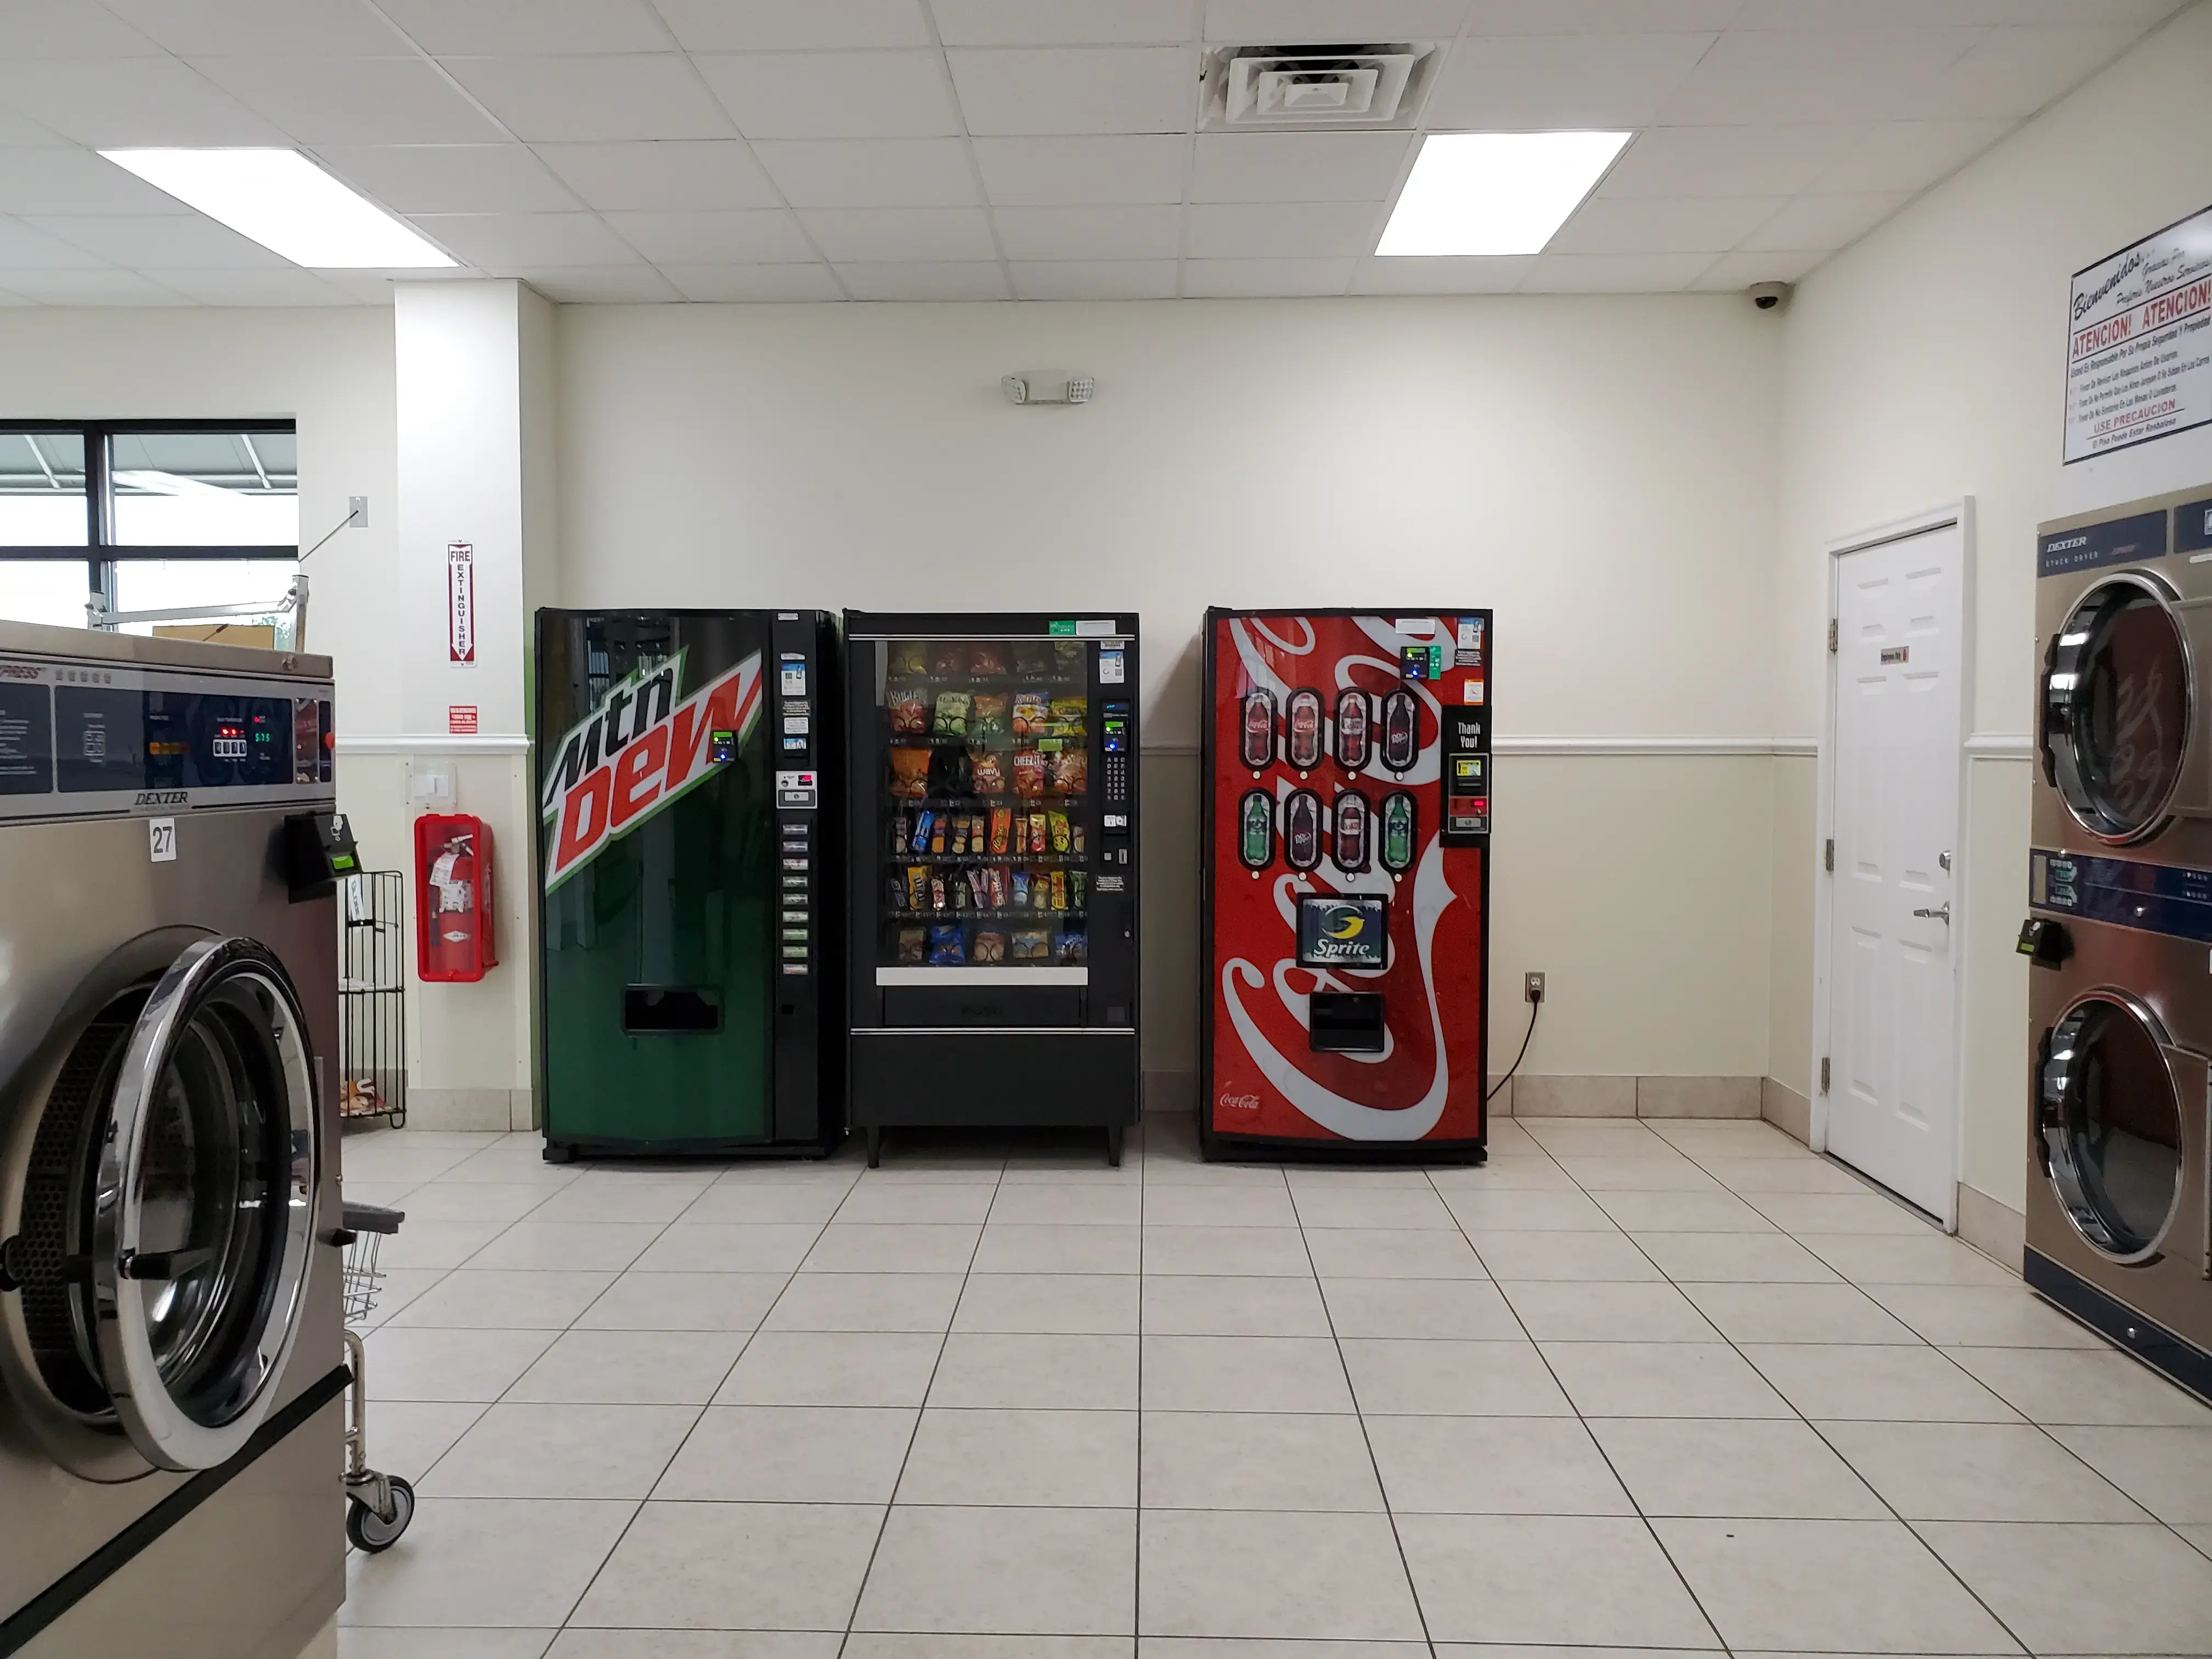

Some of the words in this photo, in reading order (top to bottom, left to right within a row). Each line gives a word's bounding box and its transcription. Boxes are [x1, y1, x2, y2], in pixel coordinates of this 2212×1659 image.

[2072, 314, 2132, 358] ATENCION!
[2142, 279, 2211, 330] ATENCION!
[2094, 419, 2112, 433] USE
[2114, 398, 2176, 427] PRECAUCION
[2046, 536, 2087, 553] DEXTER
[450, 550, 471, 562] FIRE
[456, 564, 466, 655] EXTINGUISHER
[1458, 722, 1481, 735] Thank
[1460, 736, 1477, 748] You!
[134, 792, 188, 805] DEXTER
[153, 826, 173, 854] 27
[1313, 938, 1370, 957] Sprite
